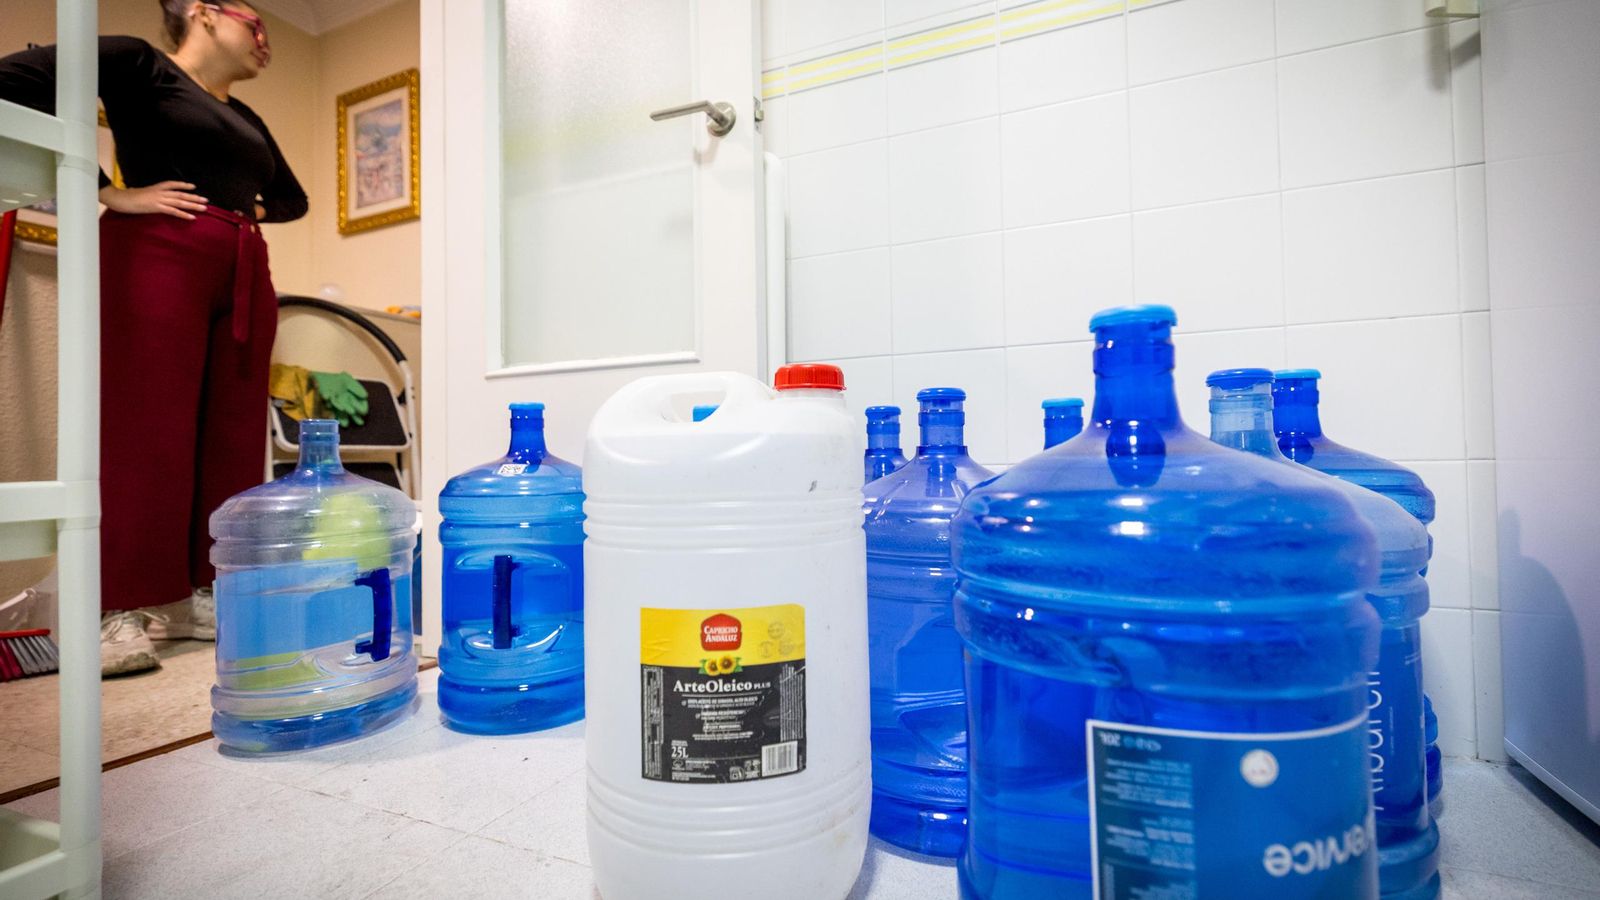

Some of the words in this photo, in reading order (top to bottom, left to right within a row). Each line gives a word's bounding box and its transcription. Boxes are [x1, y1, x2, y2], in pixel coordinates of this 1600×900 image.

[704, 625, 738, 634] CAPRICHO
[705, 633, 738, 643] ANDALUZ
[673, 678, 752, 692] ArteOleico
[753, 681, 771, 690] PLUS
[671, 746, 689, 758] 25L
